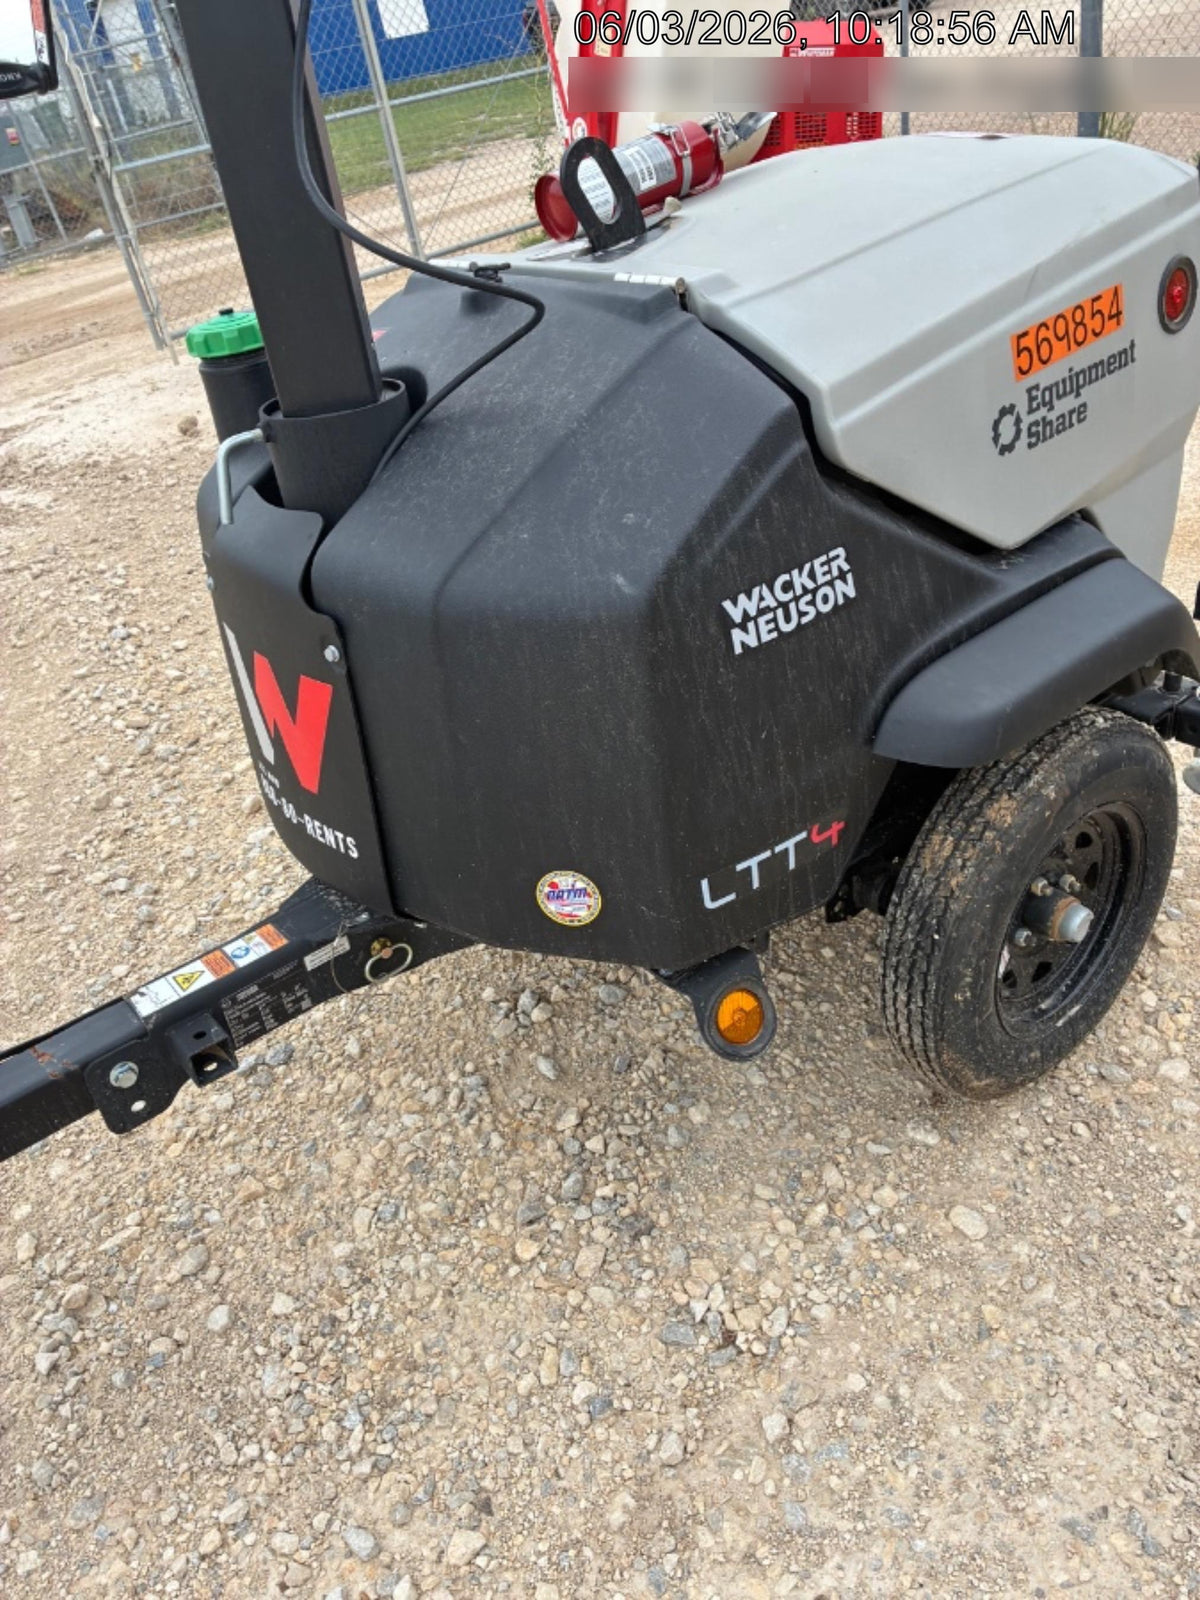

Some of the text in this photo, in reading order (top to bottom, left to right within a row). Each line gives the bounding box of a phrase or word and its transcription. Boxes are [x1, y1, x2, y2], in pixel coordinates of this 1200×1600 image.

[1016, 285, 1123, 376] 569854
[1025, 338, 1137, 415] Equipment
[1026, 401, 1088, 450] Share
[721, 547, 851, 624] WACKER
[730, 572, 856, 655] NEUSON
[701, 820, 846, 910] LTT4
